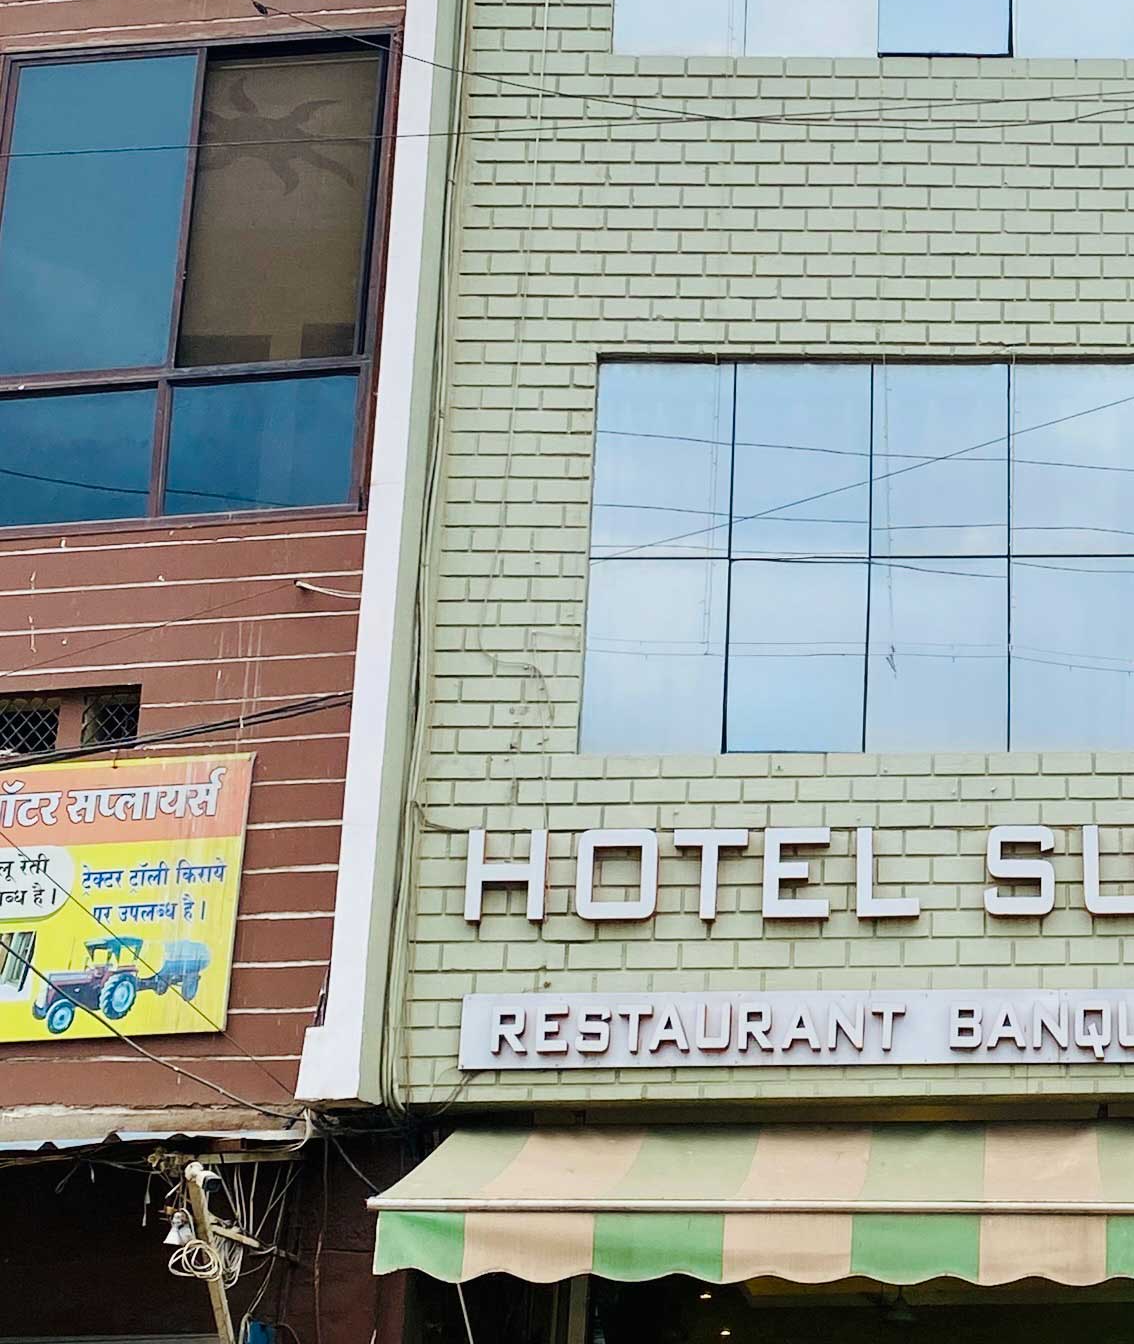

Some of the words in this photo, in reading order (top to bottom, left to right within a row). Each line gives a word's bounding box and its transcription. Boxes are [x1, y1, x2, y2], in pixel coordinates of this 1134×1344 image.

[66, 766, 227, 824] सप्लायर्स
[176, 857, 228, 886] किराये
[463, 826, 920, 922] HOTEL
[490, 1002, 906, 1056] RESTAURANT
